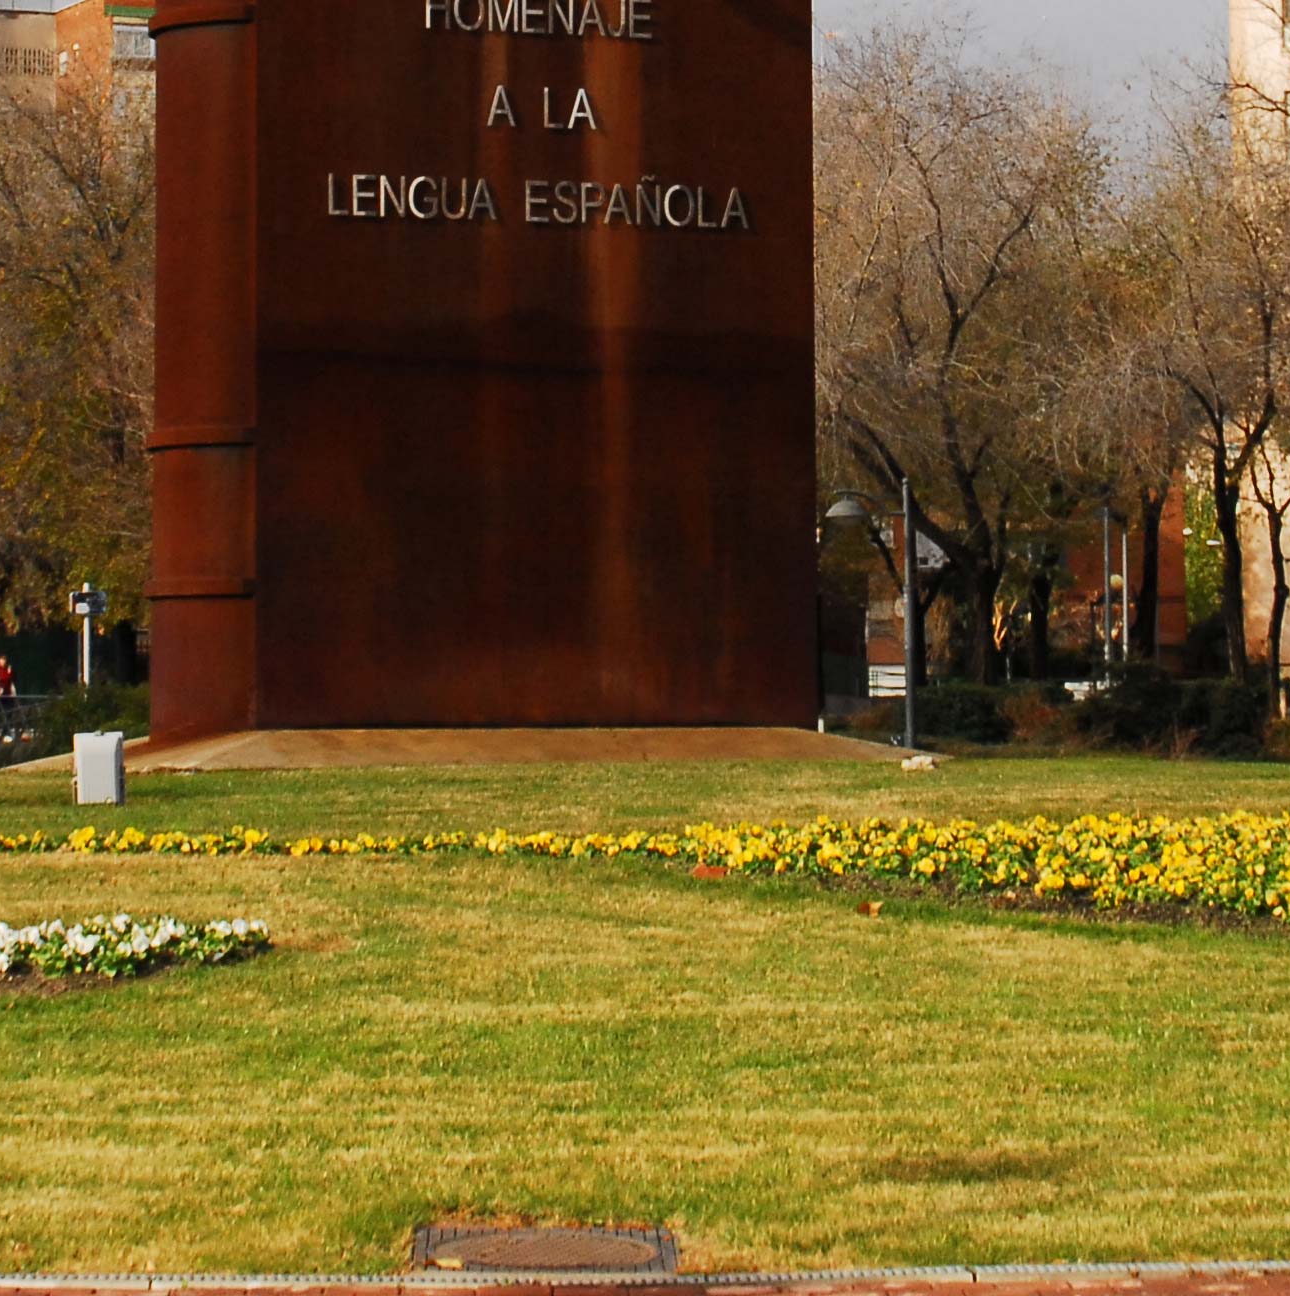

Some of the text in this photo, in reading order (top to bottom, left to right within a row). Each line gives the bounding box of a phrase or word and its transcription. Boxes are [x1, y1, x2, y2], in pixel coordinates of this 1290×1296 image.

[487, 85, 596, 129] A LA
[328, 173, 749, 229] LENGUA ESPAÑOLA
